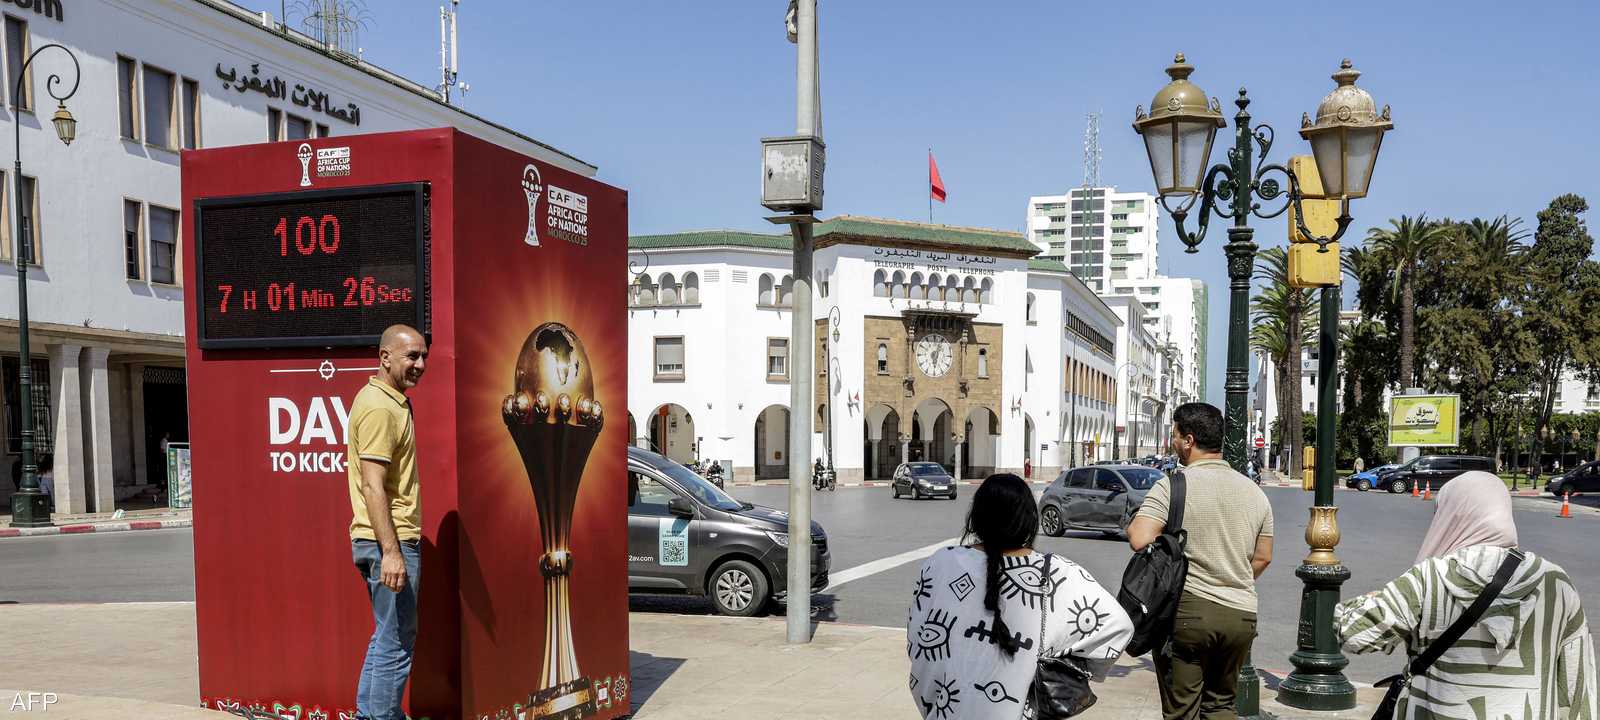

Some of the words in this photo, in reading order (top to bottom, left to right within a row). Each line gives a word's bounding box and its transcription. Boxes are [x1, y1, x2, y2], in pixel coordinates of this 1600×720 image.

[215, 63, 287, 100] المغرب
[292, 84, 361, 126] اتصالات
[549, 190, 570, 203] CAF
[548, 204, 573, 221] AFRICA
[574, 212, 588, 225] CUP
[273, 214, 341, 257] 100
[548, 216, 558, 227] OF
[559, 219, 588, 236] NATIONS
[548, 227, 580, 244] MOROCCO
[927, 264, 947, 272] POSTE
[217, 285, 233, 313] 7
[243, 290, 257, 310] H
[267, 282, 295, 311] 01
[302, 288, 335, 308] Min
[269, 396, 349, 445] DAY
[270, 451, 296, 472] TO
[300, 451, 349, 473] KICK-
